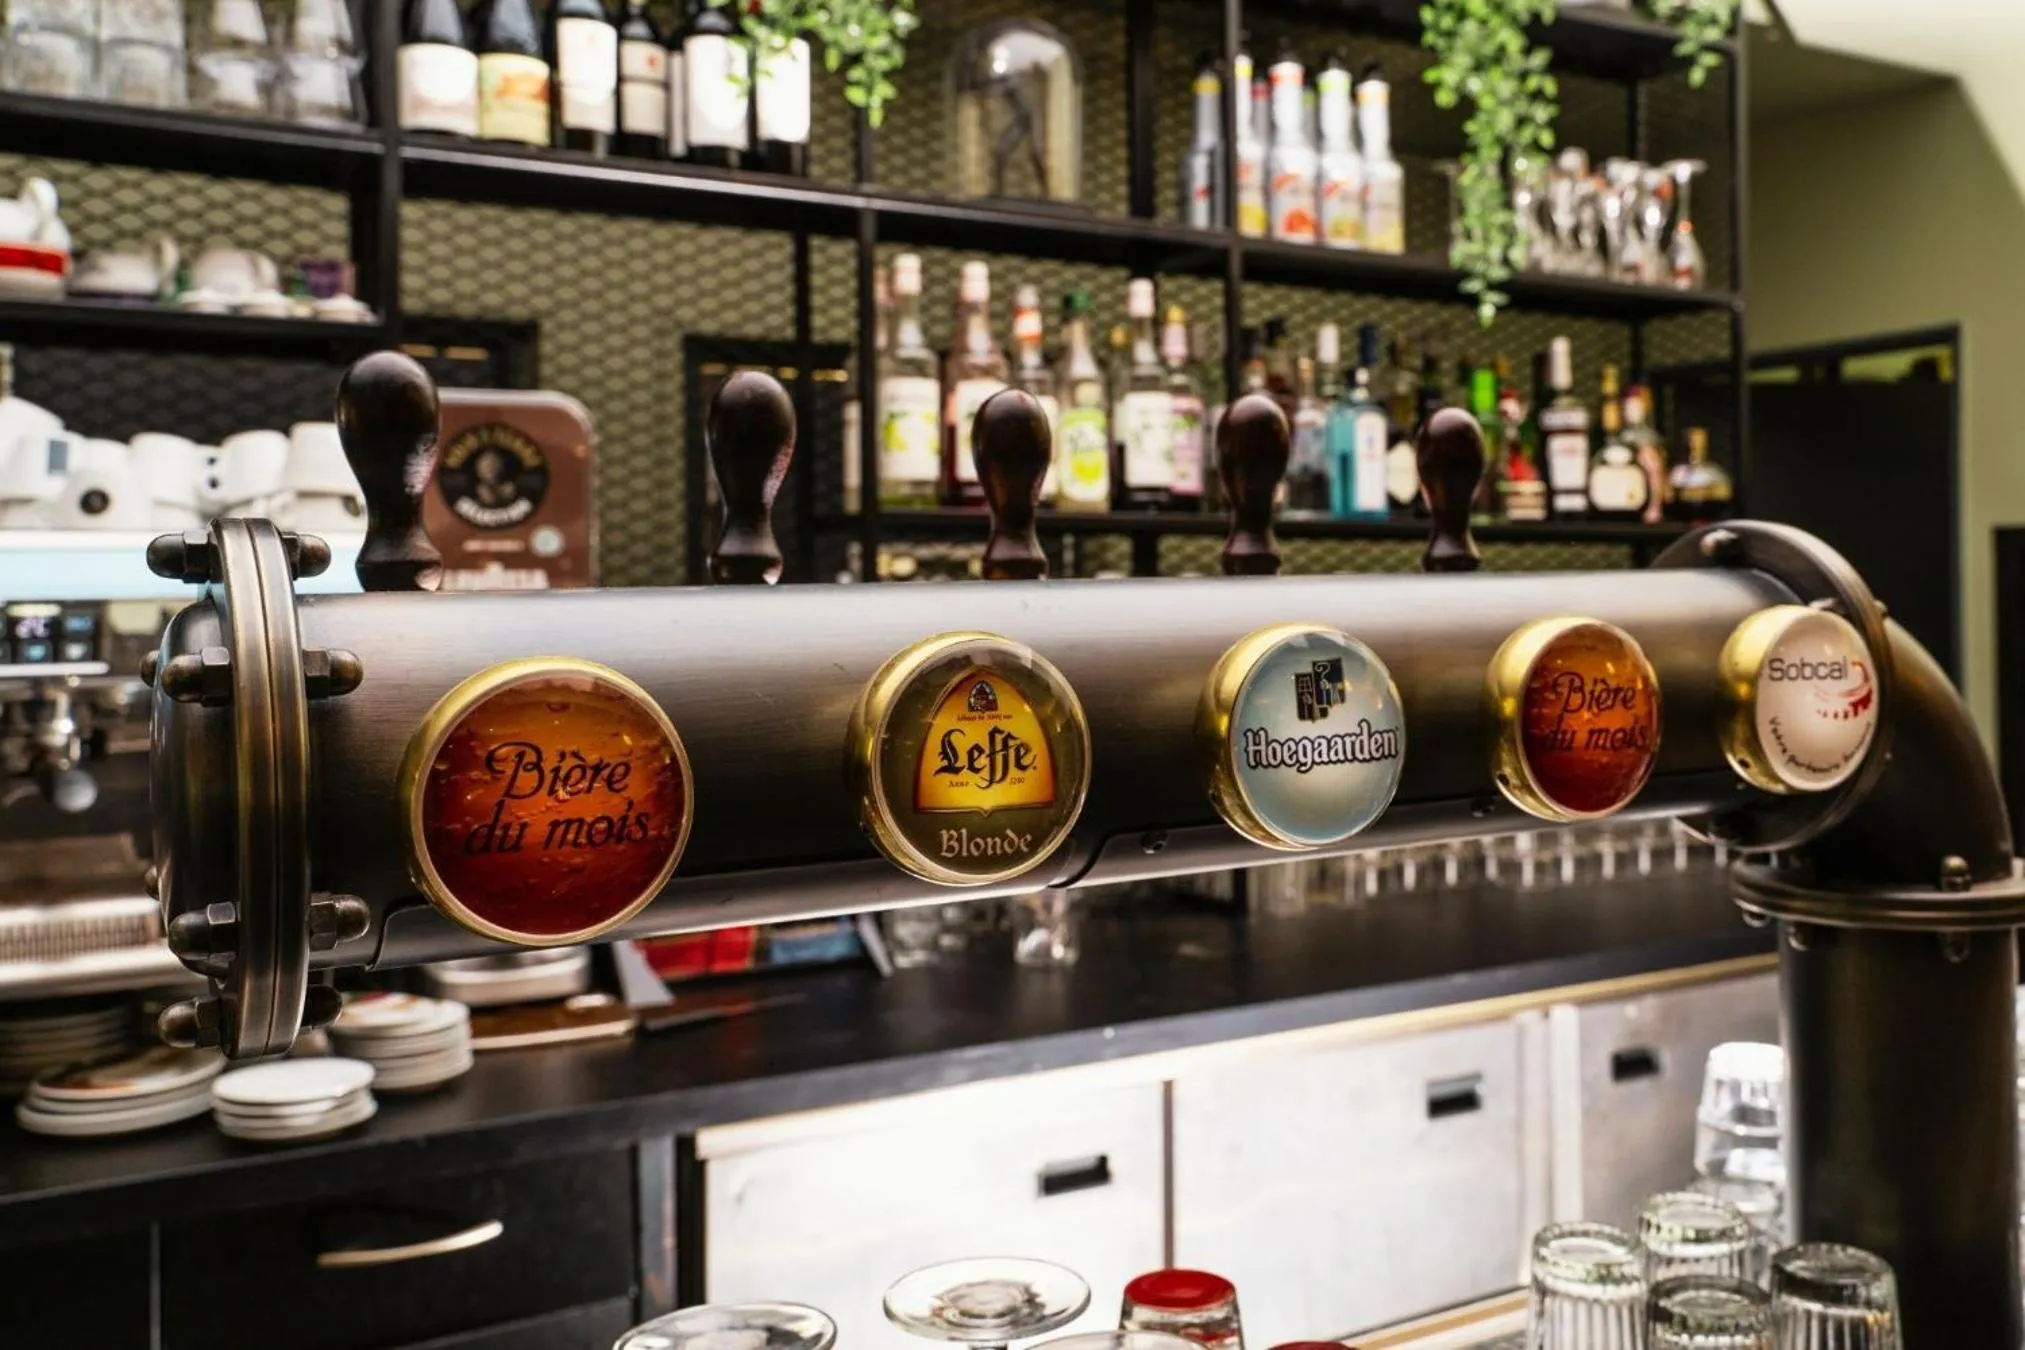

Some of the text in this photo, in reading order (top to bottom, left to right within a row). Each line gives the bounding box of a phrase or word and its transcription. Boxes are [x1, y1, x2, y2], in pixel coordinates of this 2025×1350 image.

[1553, 671, 1636, 714] Bière
[1768, 656, 1848, 682] Sobcal
[1245, 719, 1399, 773] Hoegaarden
[1544, 713, 1648, 751] du mois
[485, 741, 632, 801] Bière
[933, 726, 1037, 790] Leffe
[464, 800, 649, 856] du mois
[940, 828, 1033, 858] Blonde
